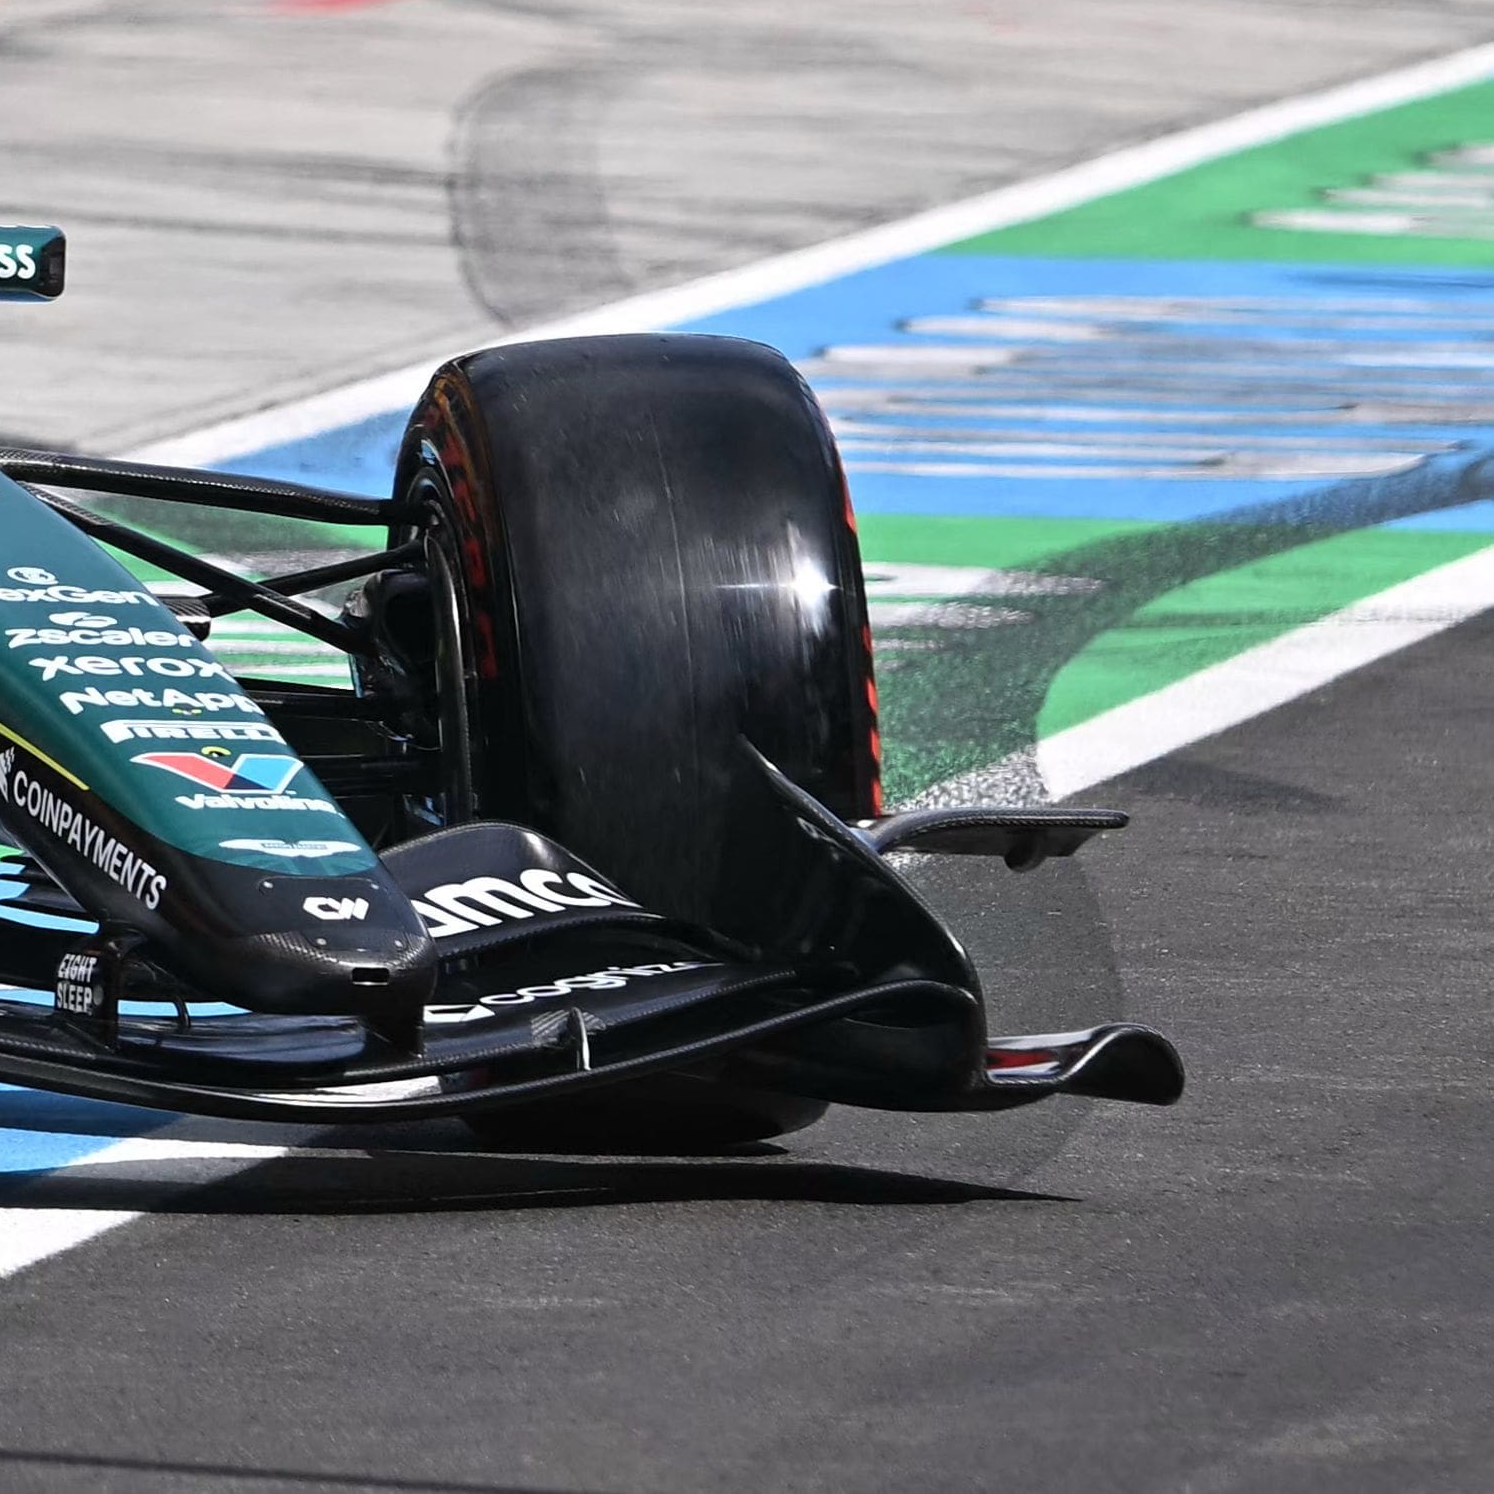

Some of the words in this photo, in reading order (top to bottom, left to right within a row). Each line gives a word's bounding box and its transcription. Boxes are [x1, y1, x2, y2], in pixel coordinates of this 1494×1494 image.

[4, 626, 202, 649] zscaler
[28, 655, 238, 684] xerox
[59, 687, 266, 715] NetApp
[13, 770, 167, 911] COINPAYMENTS
[57, 953, 98, 980] EIGHT
[56, 981, 93, 1015] SLEEP
